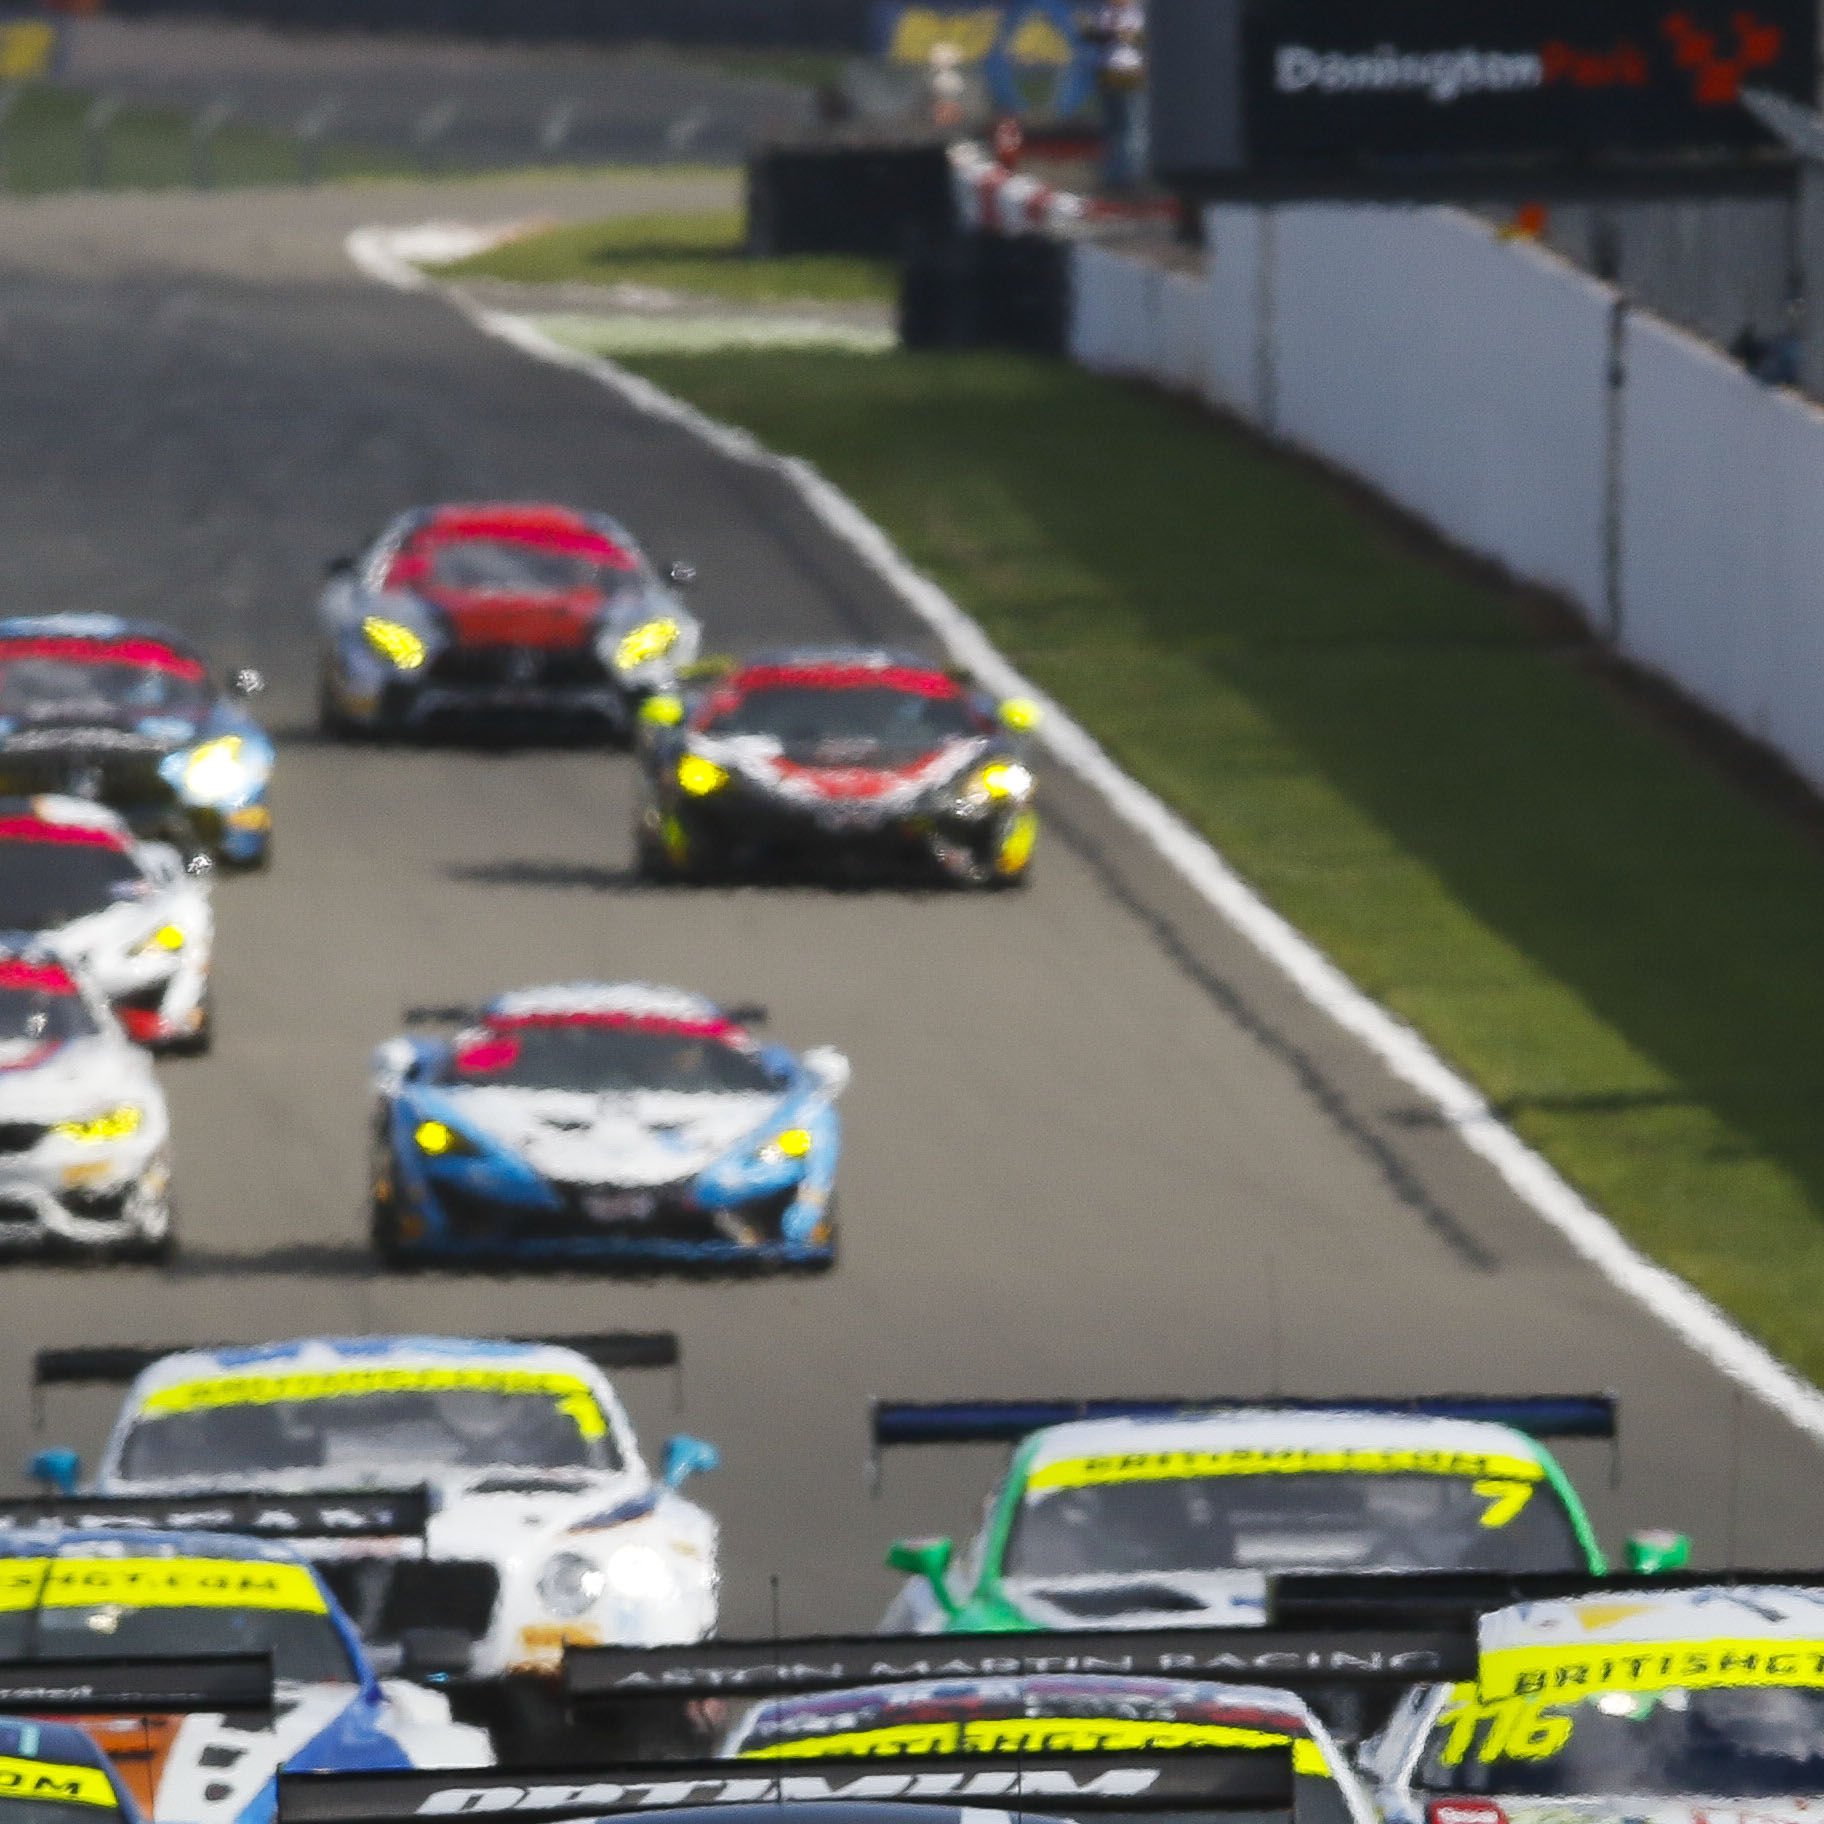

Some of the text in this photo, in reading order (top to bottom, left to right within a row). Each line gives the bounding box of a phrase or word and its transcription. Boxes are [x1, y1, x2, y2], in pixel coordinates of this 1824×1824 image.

[1473, 1481, 1533, 1527] 7
[871, 1654, 1134, 1676] MARTIN
[1159, 1650, 1440, 1671] RACING
[1437, 1684, 1574, 1766] 116
[415, 1768, 1160, 1814] OPTIMUM
